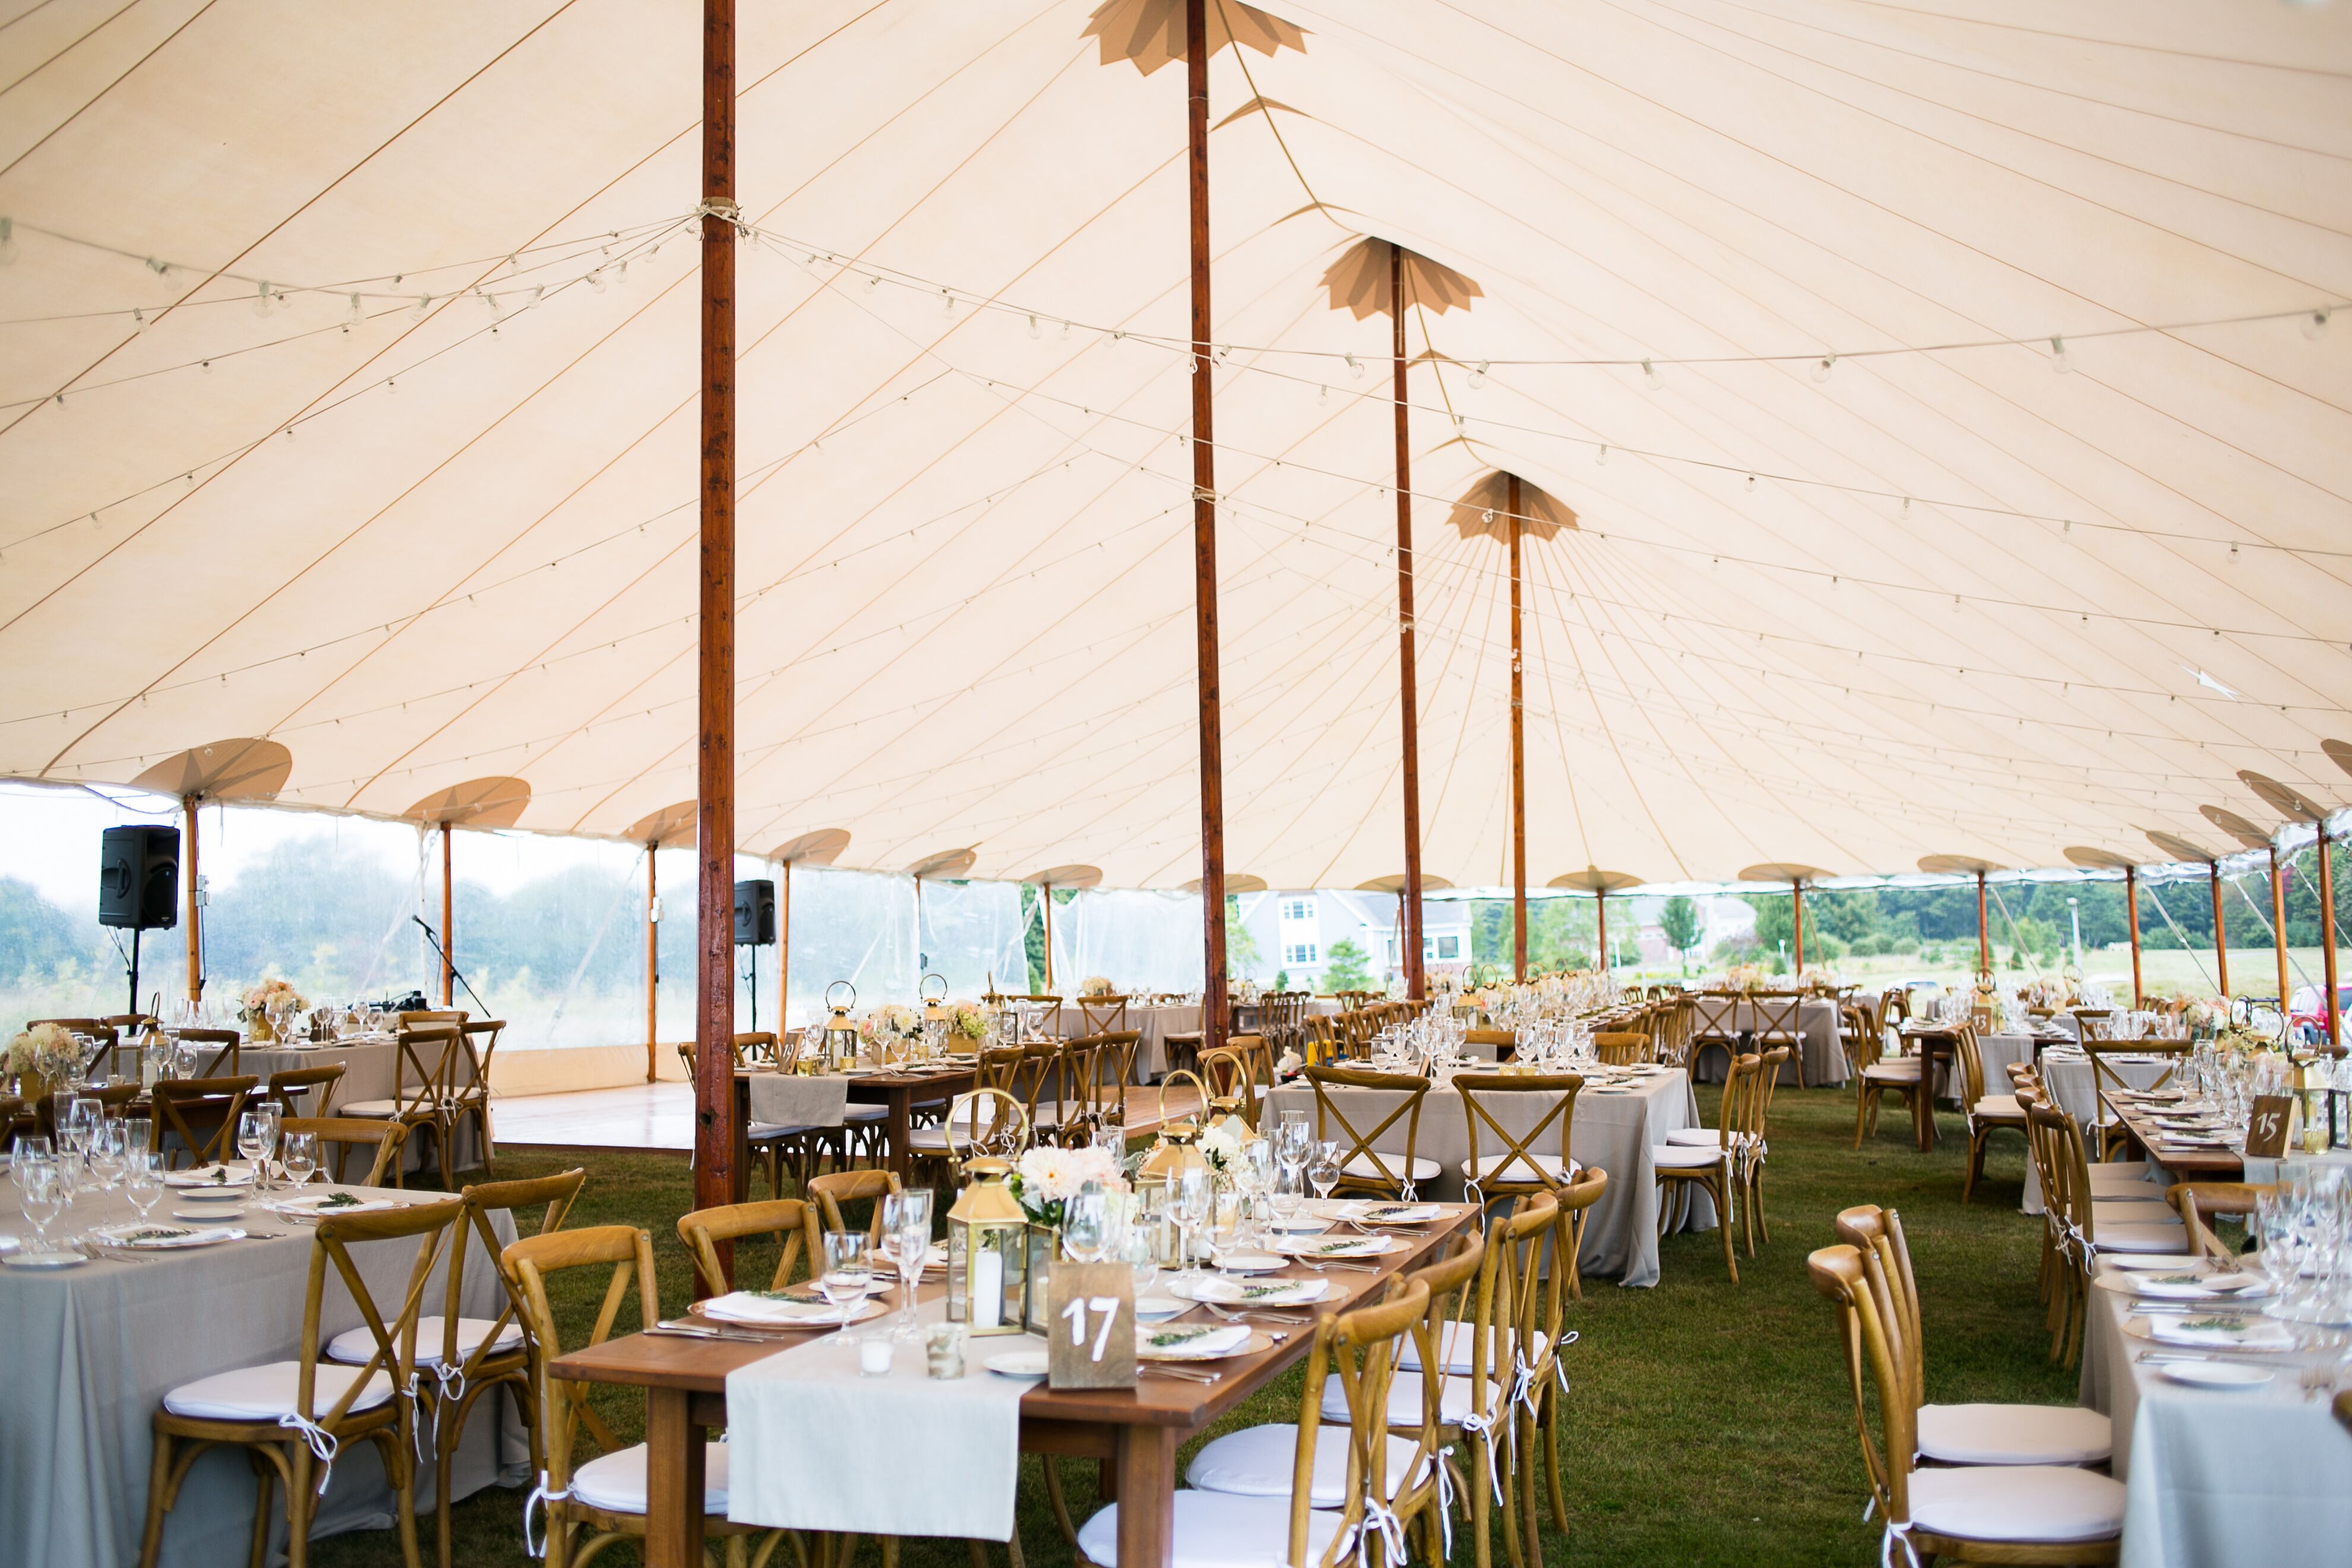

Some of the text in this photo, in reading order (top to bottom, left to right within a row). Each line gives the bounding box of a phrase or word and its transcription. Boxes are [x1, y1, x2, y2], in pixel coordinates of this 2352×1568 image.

[1972, 1014, 1987, 1030] 13
[782, 1044, 794, 1063] 19
[2257, 1113, 2281, 1142] 15
[1061, 1296, 1120, 1362] 17
